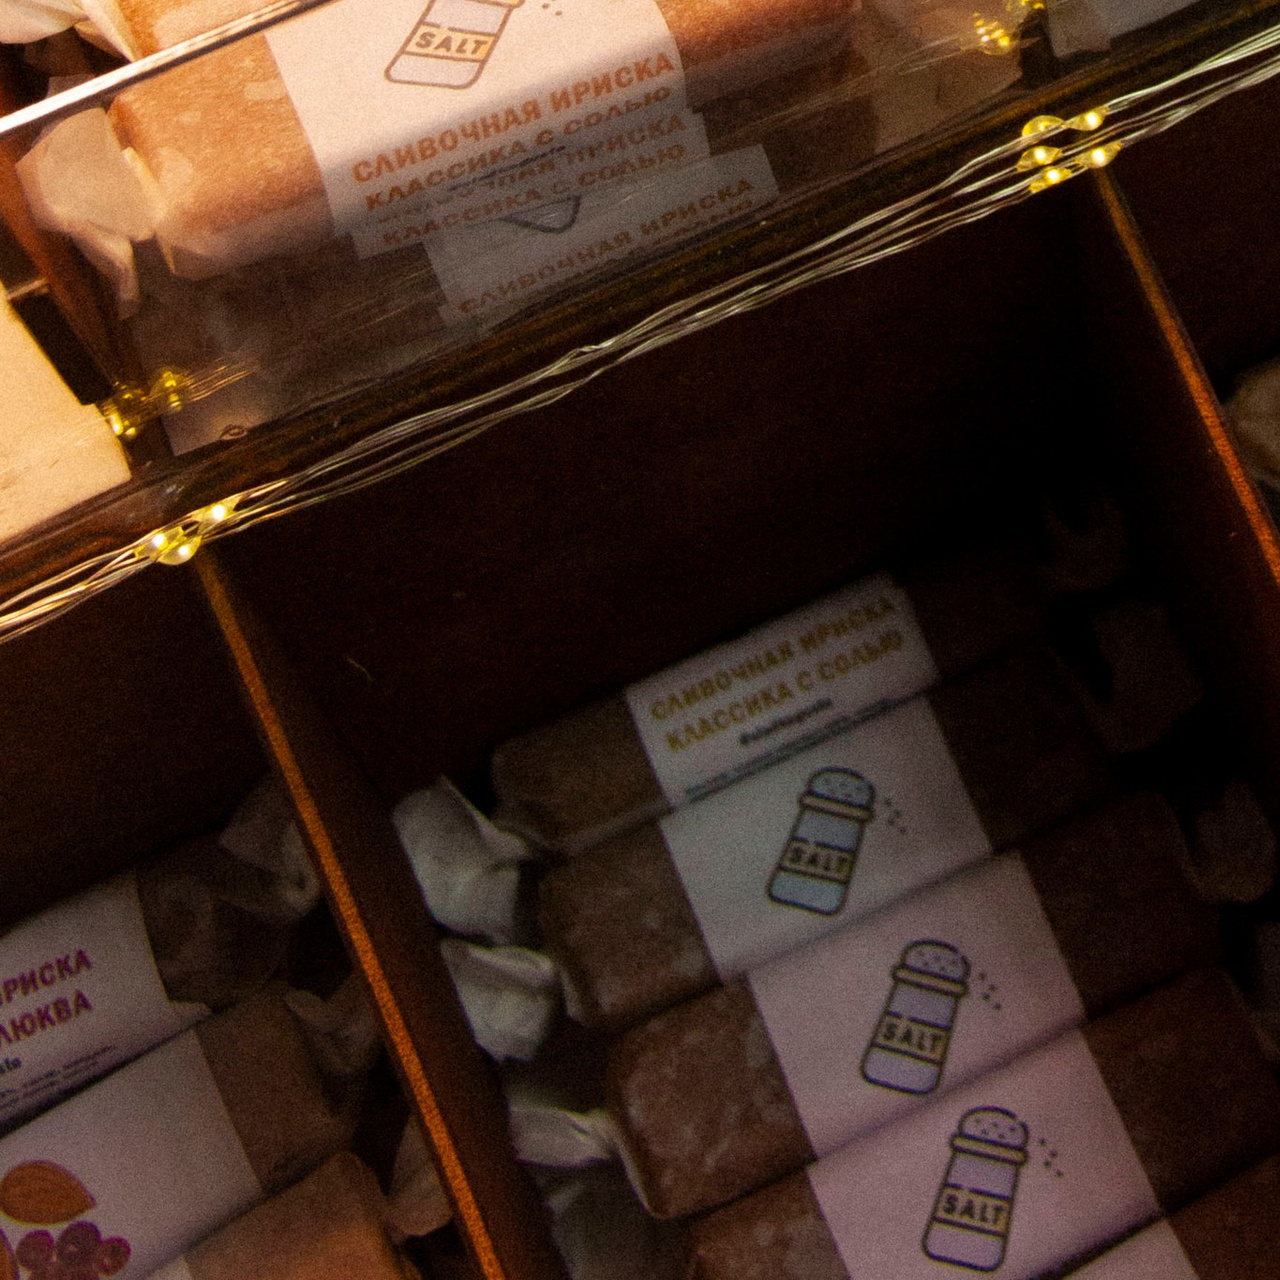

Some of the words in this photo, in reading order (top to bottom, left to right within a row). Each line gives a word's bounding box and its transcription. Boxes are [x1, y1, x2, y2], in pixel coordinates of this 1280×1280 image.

[415, 30, 488, 56] SALT
[351, 97, 543, 184] СЛИВОЧНАЯ
[550, 51, 675, 114] ИРИСКА
[365, 140, 529, 212] КЛАССИКА
[534, 128, 555, 148] С
[562, 86, 672, 137] СОЛЬЮ
[381, 187, 544, 244] КЛАССИКА
[577, 143, 686, 188] СОЛЬЮ
[458, 230, 632, 315] СЛИВОЧНАЯ
[639, 177, 752, 238] ИРИСКА
[650, 639, 795, 721] СЛИВОЧНАЯ
[663, 681, 794, 754] КЛАССИКА
[794, 670, 814, 692] С
[0, 948, 93, 1007] РИСКА
[882, 1021, 945, 1055] SALT
[941, 1192, 1006, 1227] SALT
